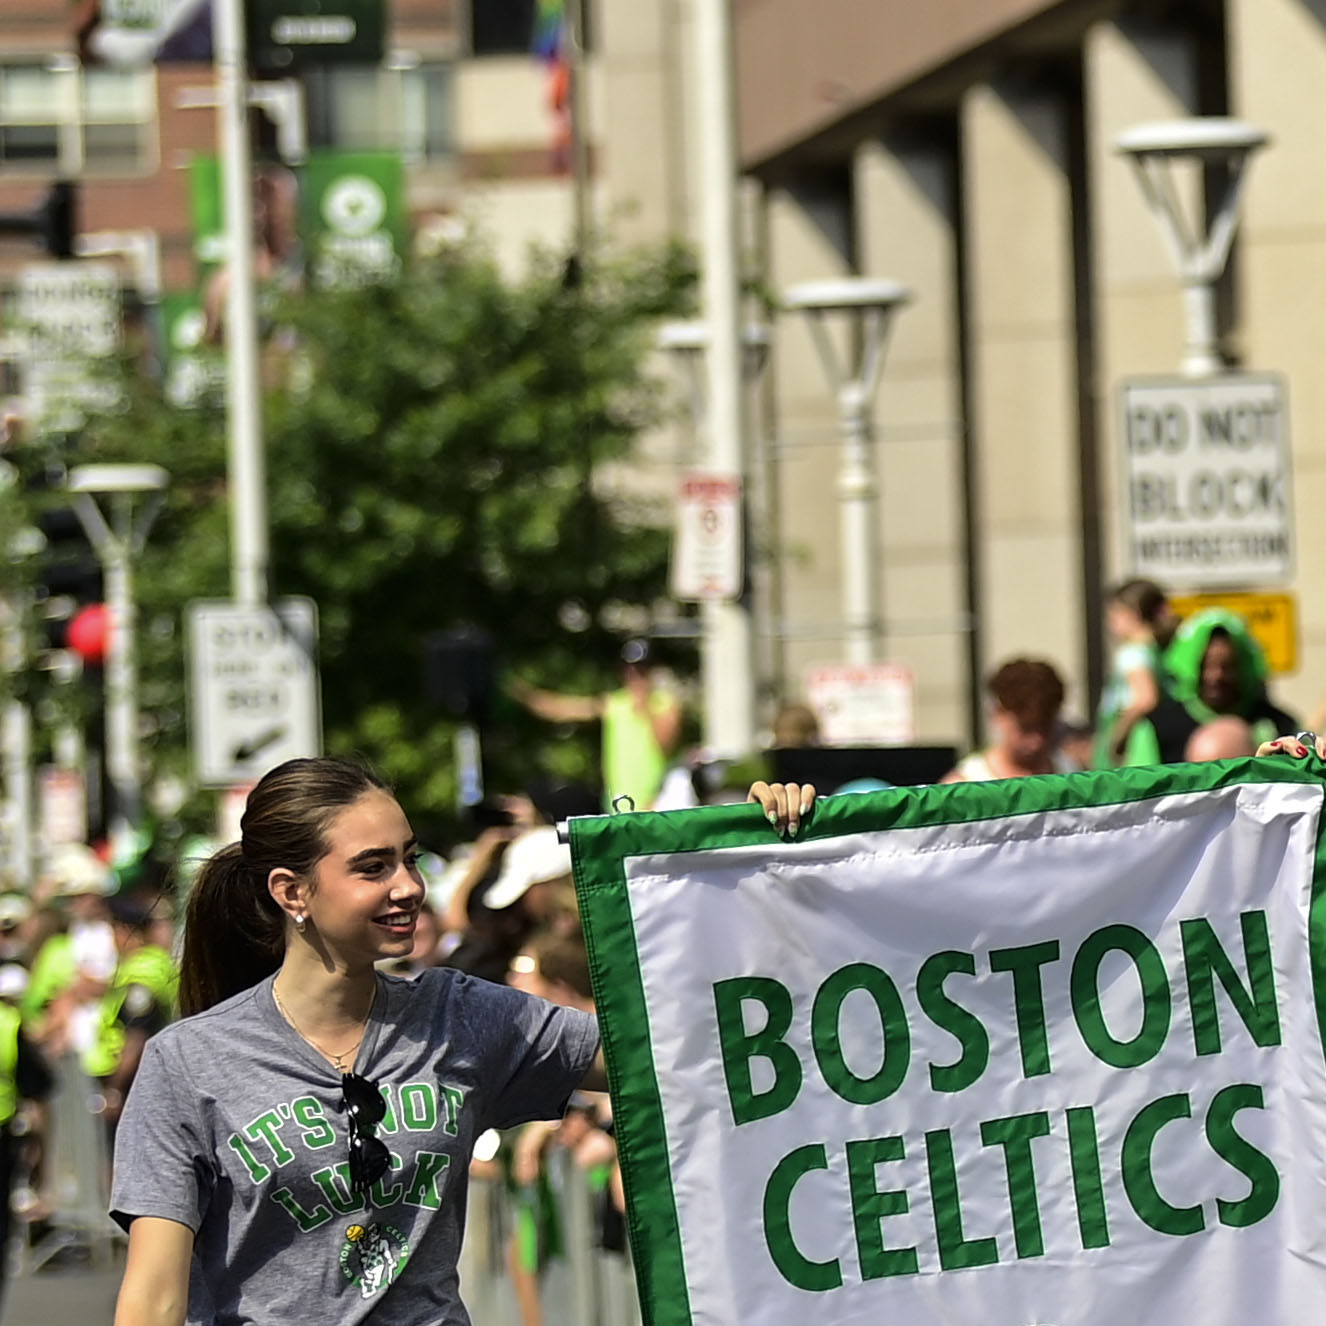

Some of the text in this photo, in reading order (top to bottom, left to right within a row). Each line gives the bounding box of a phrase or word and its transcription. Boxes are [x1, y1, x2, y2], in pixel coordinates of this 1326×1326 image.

[1129, 401, 1279, 453] DO NOT
[1131, 471, 1286, 522] BLOCK
[713, 910, 1282, 1126] BOSTON
[227, 1095, 336, 1184] IT'S
[272, 1151, 451, 1232] LUCK
[763, 1083, 1280, 1292] CELTICS
